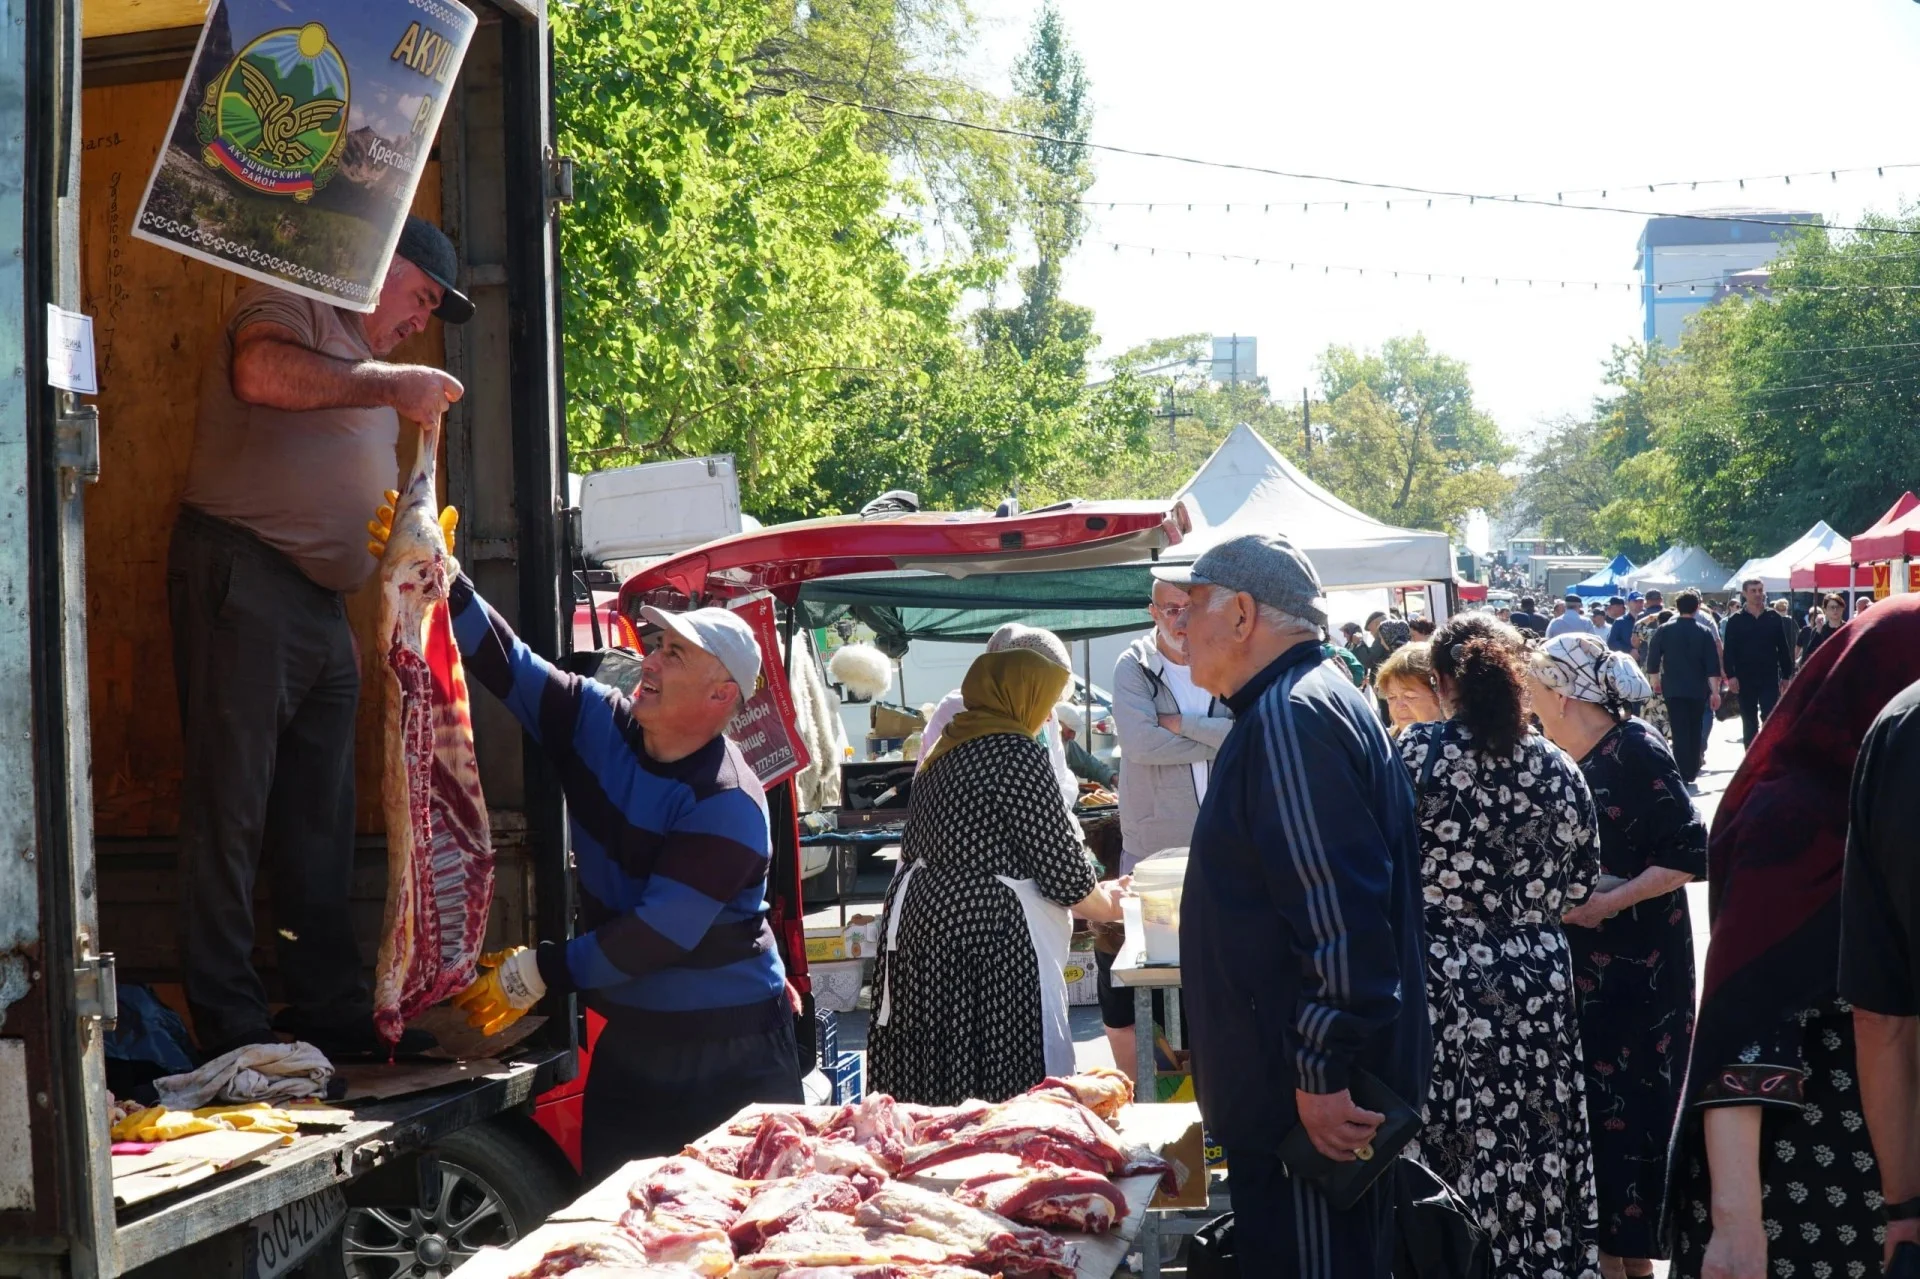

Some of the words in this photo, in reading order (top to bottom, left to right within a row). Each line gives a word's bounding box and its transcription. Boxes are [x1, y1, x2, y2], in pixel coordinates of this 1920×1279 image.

[228, 144, 301, 179] АКУШИНСКИЙ
[241, 167, 276, 187] РАЙОН
[734, 702, 771, 733] район
[755, 746, 791, 772] 777-77-76
